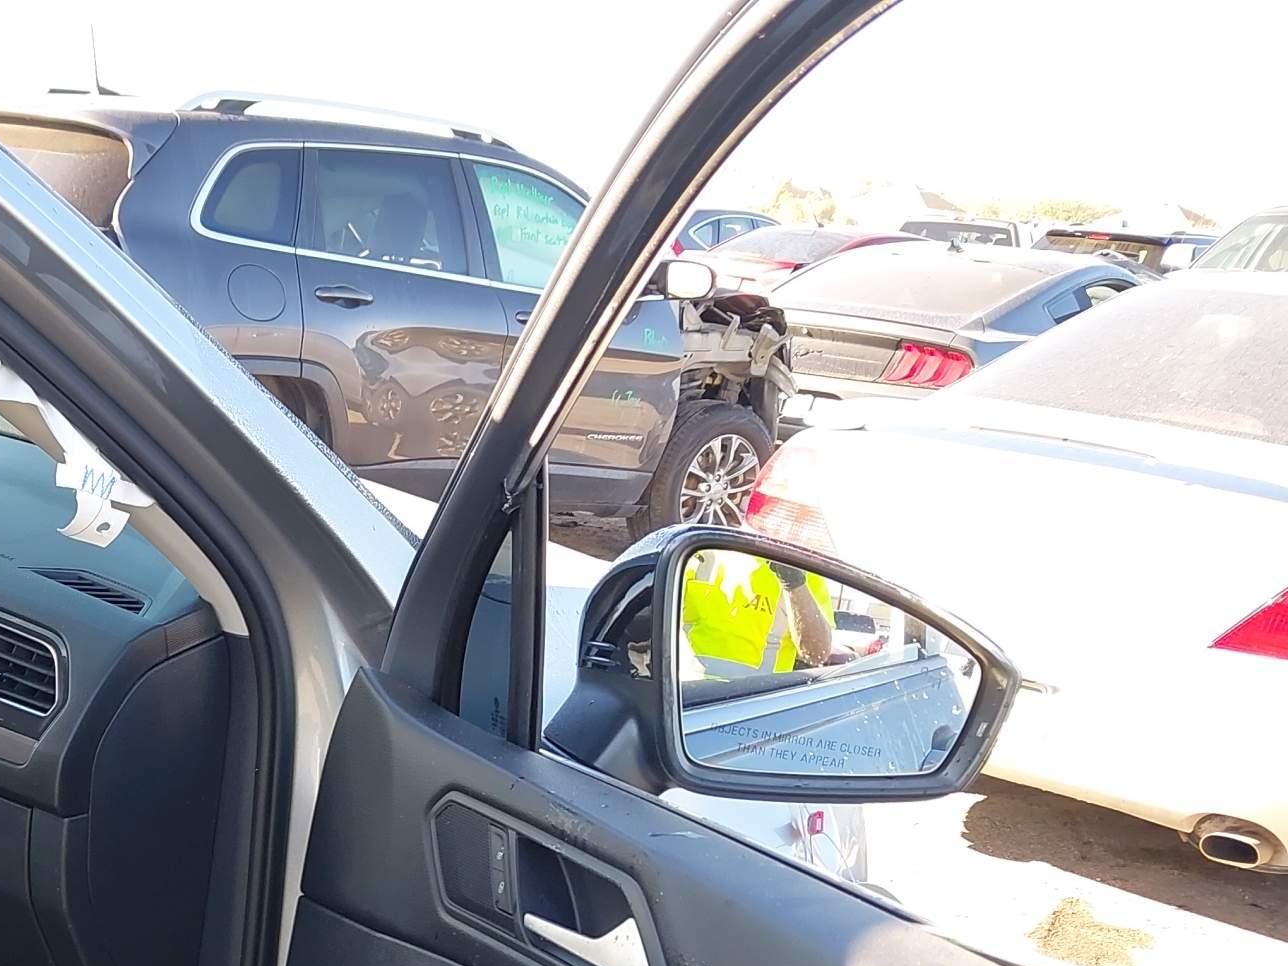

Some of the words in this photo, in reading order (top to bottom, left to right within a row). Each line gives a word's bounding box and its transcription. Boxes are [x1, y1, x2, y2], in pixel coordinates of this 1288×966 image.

[587, 433, 644, 442] CHEROKEE
[712, 723, 759, 739] BJECTS
[773, 733, 814, 748] MIRROR
[815, 739, 838, 752] ARE
[840, 742, 881, 758] CLOSER
[737, 742, 766, 757] THAN
[769, 747, 797, 762] THEY
[800, 752, 846, 769] APPEAR
